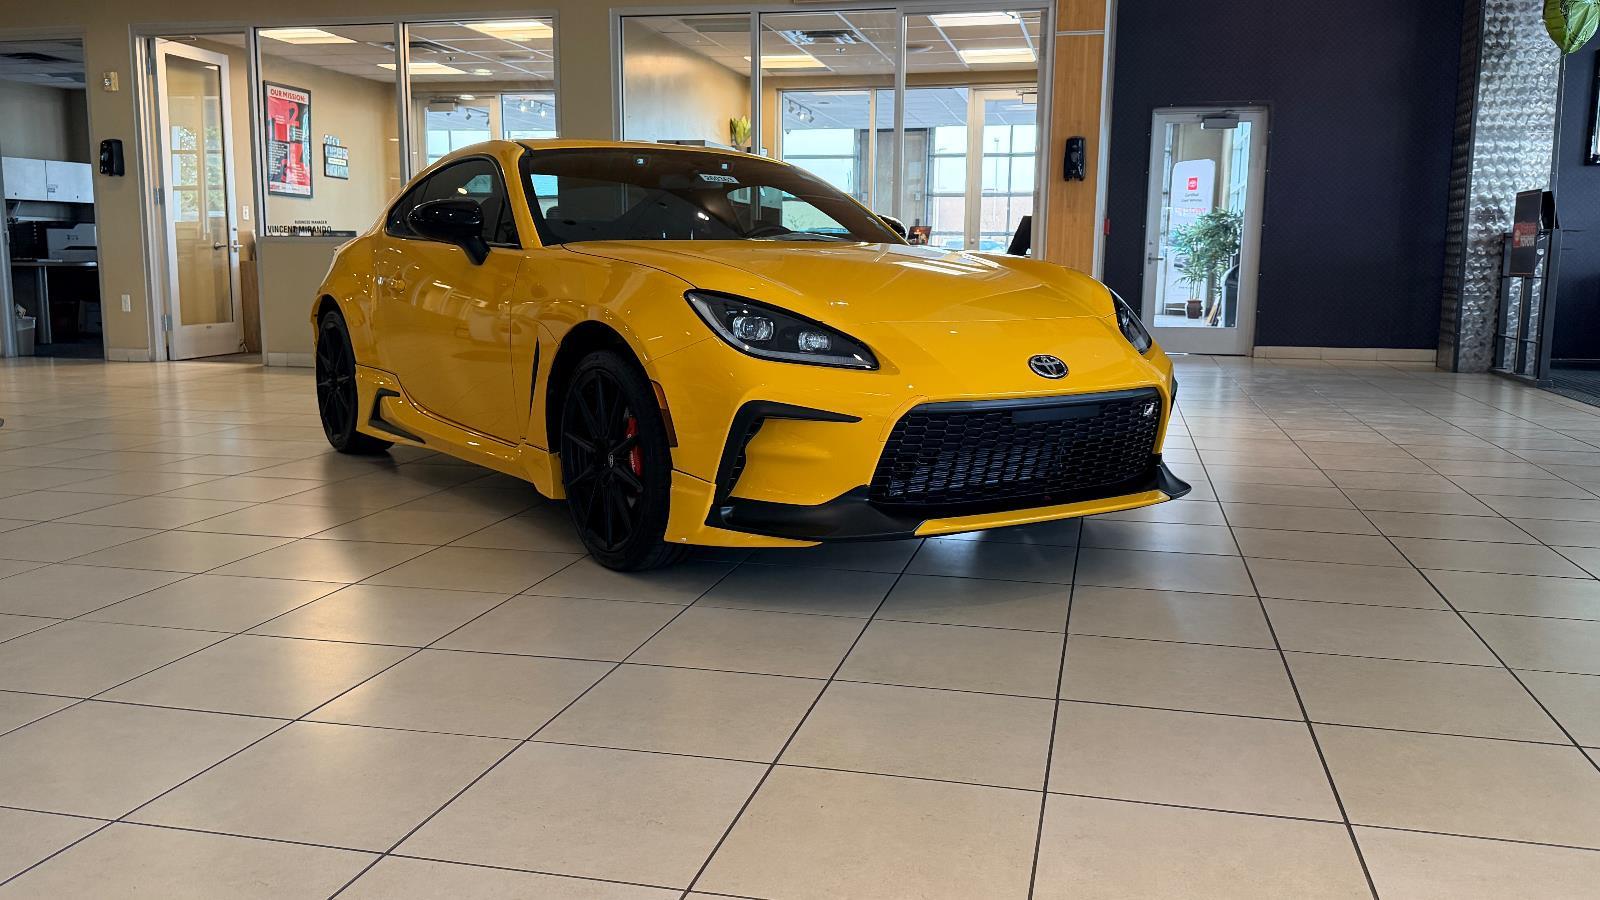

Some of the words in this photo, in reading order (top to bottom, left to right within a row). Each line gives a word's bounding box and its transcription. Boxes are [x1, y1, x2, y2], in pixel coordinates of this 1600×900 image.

[270, 88, 282, 97] OUR
[267, 225, 297, 234] VINCENT
[298, 225, 332, 235] MIRANDO
